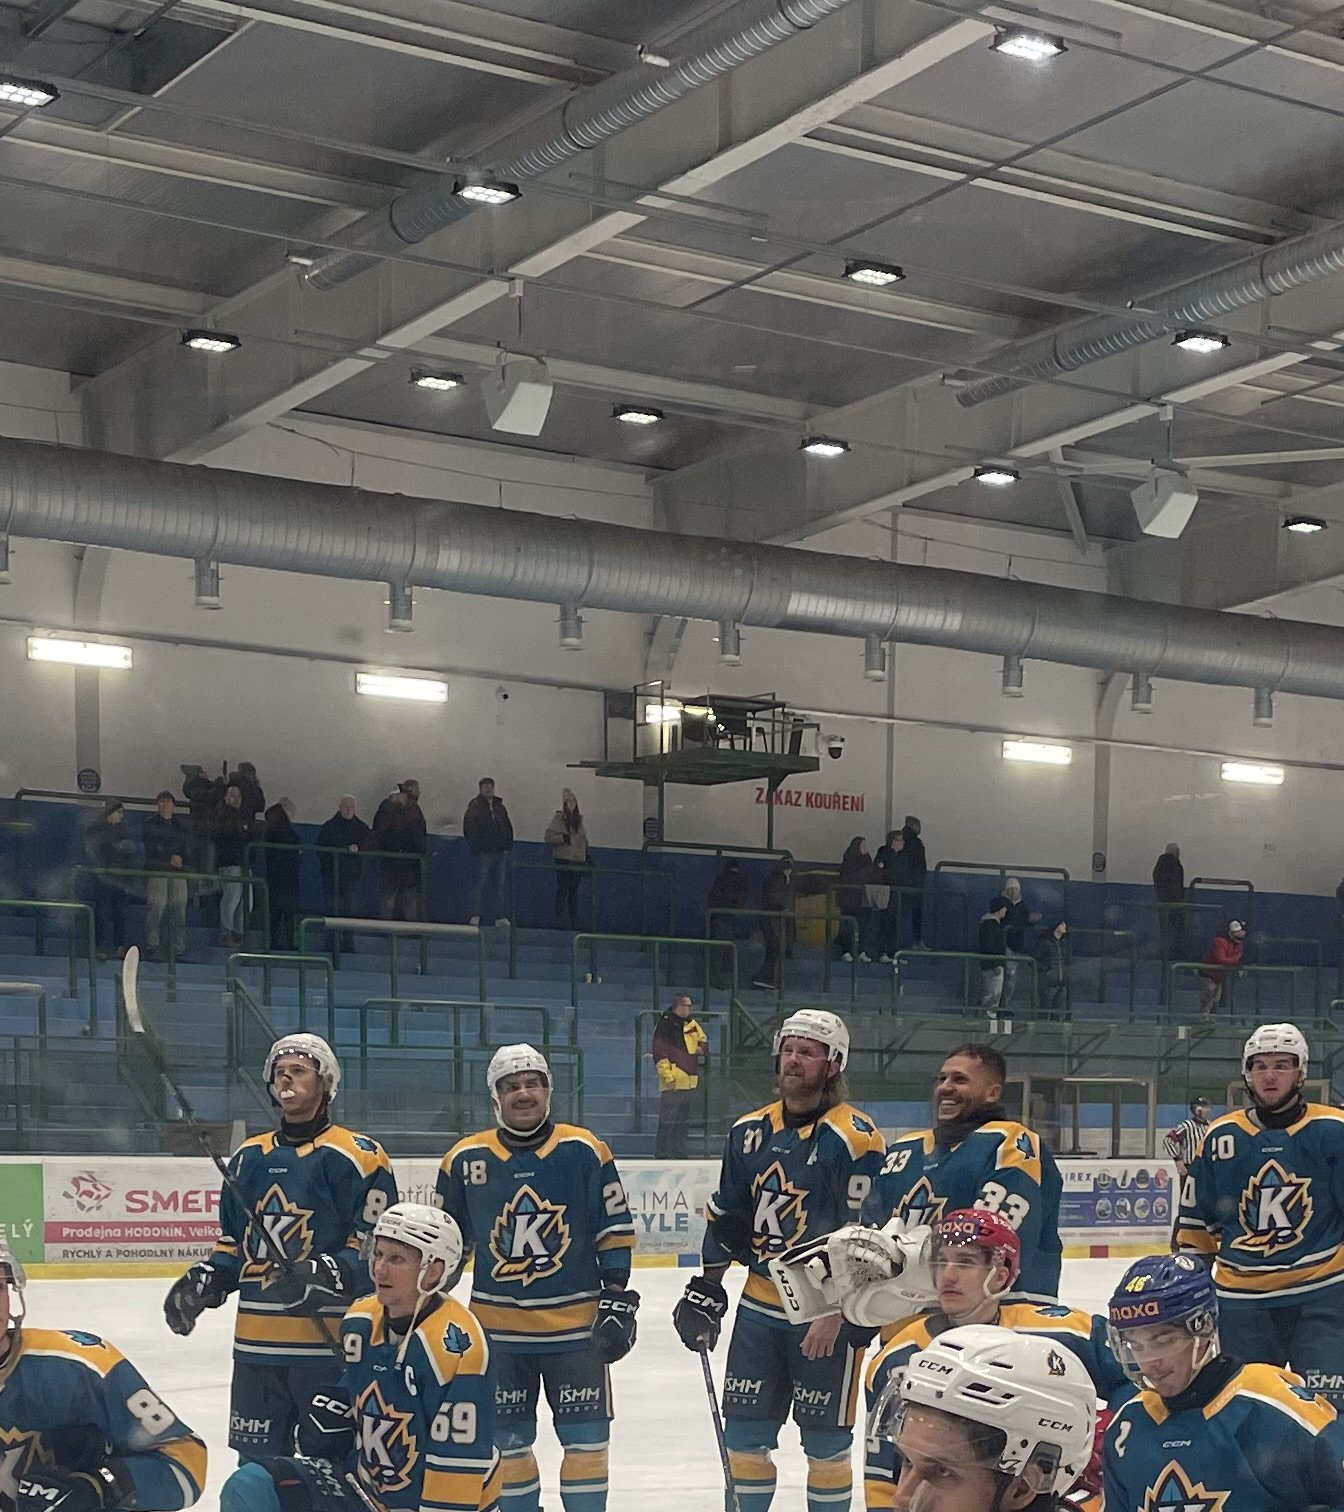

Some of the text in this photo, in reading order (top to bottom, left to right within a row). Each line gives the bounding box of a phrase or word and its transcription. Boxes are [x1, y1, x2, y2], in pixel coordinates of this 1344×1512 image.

[805, 791, 865, 812] KOUŘENÍ
[62, 1225, 121, 1240] Prodejna
[62, 1247, 102, 1259] RYCHLÝ
[776, 1269, 800, 1312] CCM
[918, 1359, 954, 1376] CCM
[430, 1401, 477, 1444] 69
[1038, 1417, 1074, 1433] CCM
[1162, 1440, 1192, 1449] CCM
